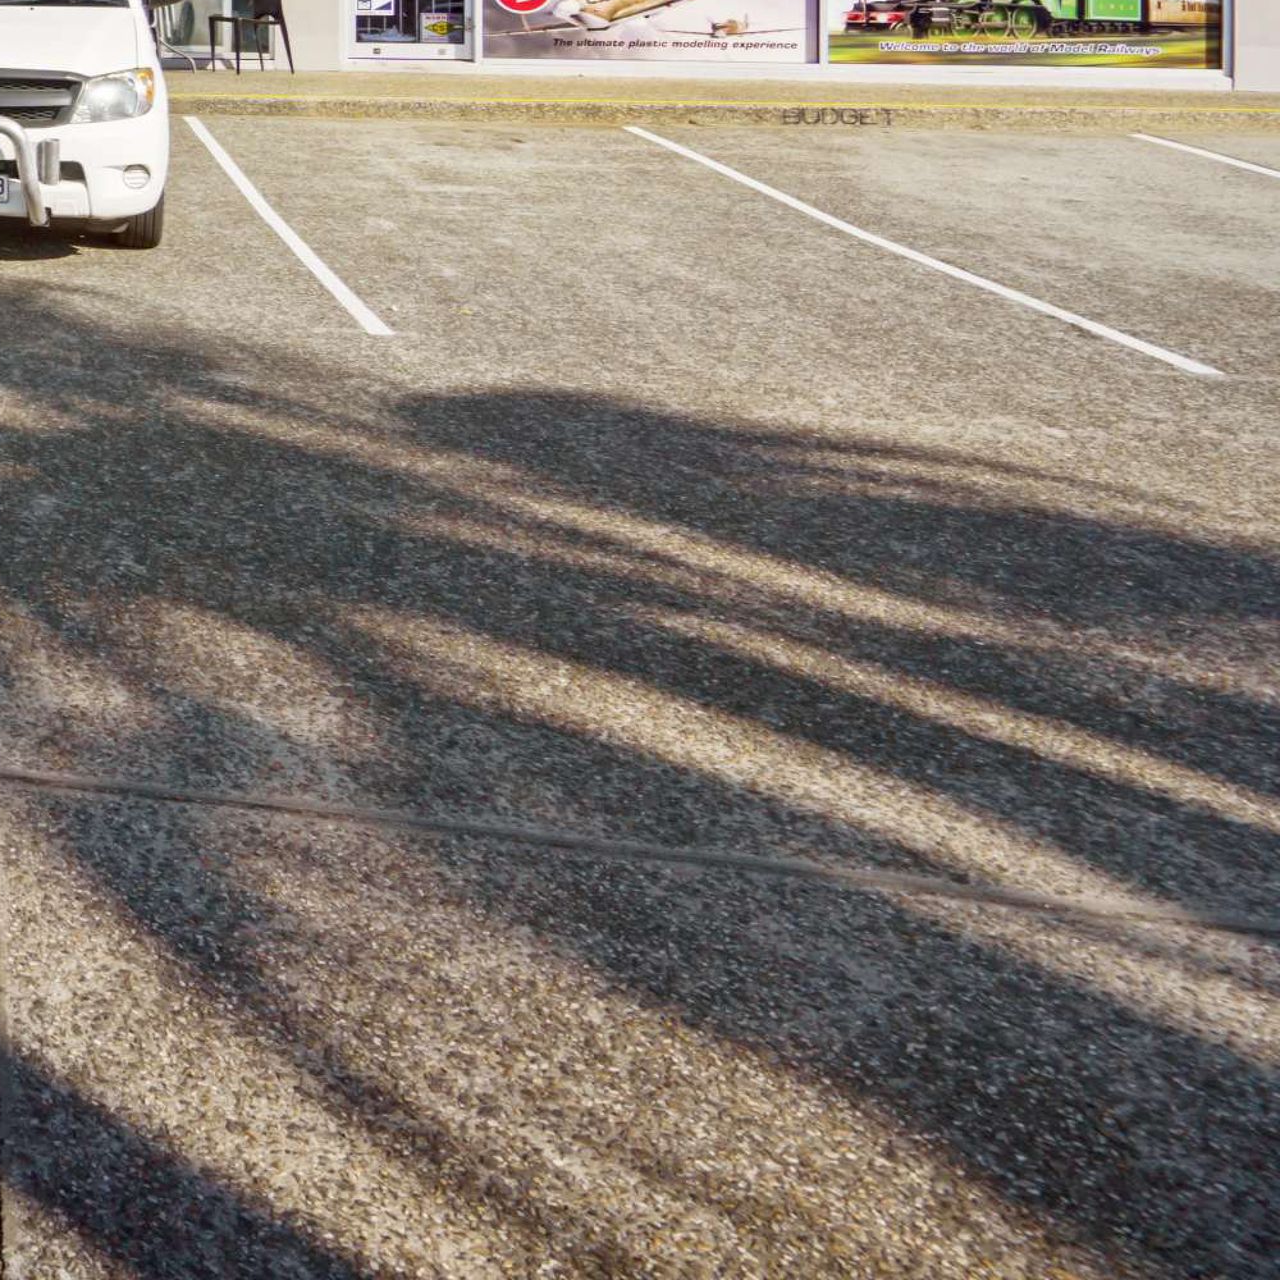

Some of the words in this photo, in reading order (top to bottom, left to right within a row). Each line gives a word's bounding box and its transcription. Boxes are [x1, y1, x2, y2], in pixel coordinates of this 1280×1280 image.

[553, 38, 573, 47] The
[576, 38, 625, 48] ultimate
[628, 38, 667, 49] plastic
[671, 39, 728, 51] modelling
[732, 41, 798, 51] experience
[878, 41, 939, 52] Welcome
[942, 42, 957, 52] to
[1048, 43, 1093, 54] Model
[1096, 44, 1163, 57] Railways
